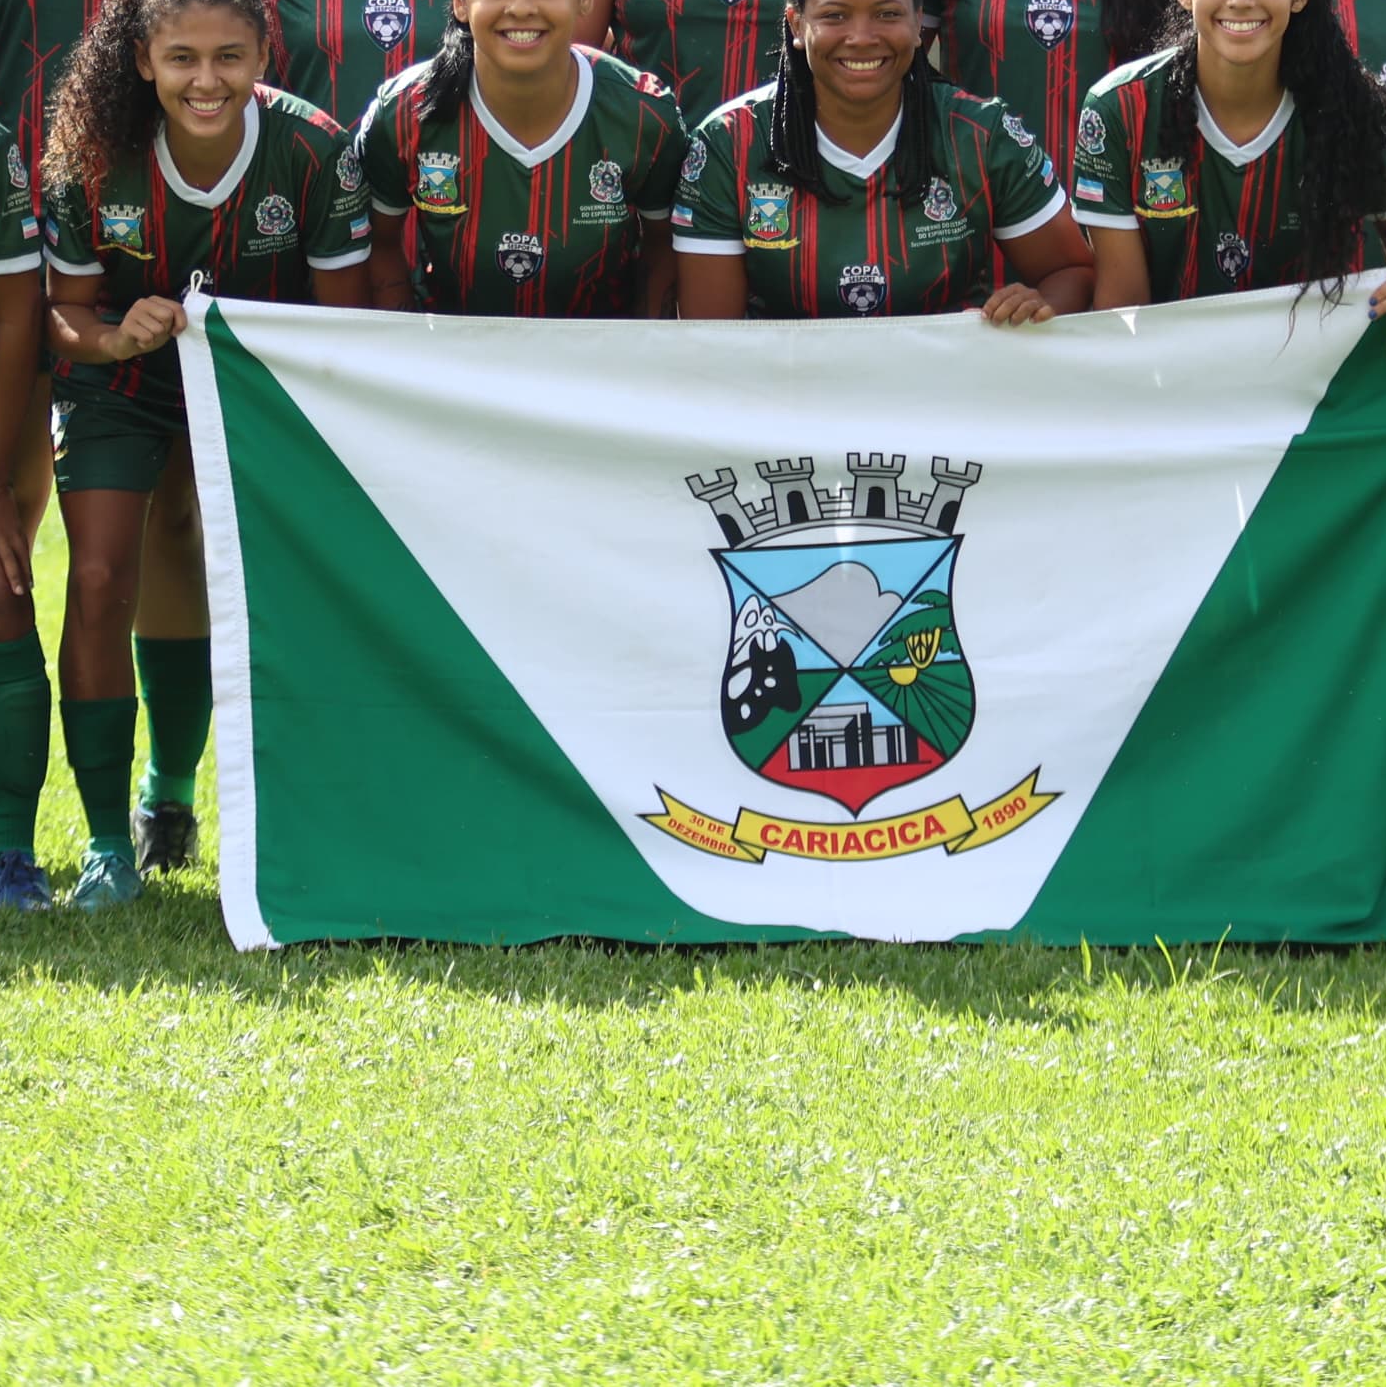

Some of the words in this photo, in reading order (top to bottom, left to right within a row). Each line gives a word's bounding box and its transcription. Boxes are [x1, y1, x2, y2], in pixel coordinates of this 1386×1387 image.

[502, 233, 539, 247] COPA
[842, 265, 881, 276] COPA
[689, 814, 705, 827] 30
[707, 821, 725, 836] DE
[982, 796, 1028, 832] 1890
[668, 817, 738, 856] DEZEMBRO
[760, 813, 947, 856] CARIACICA
